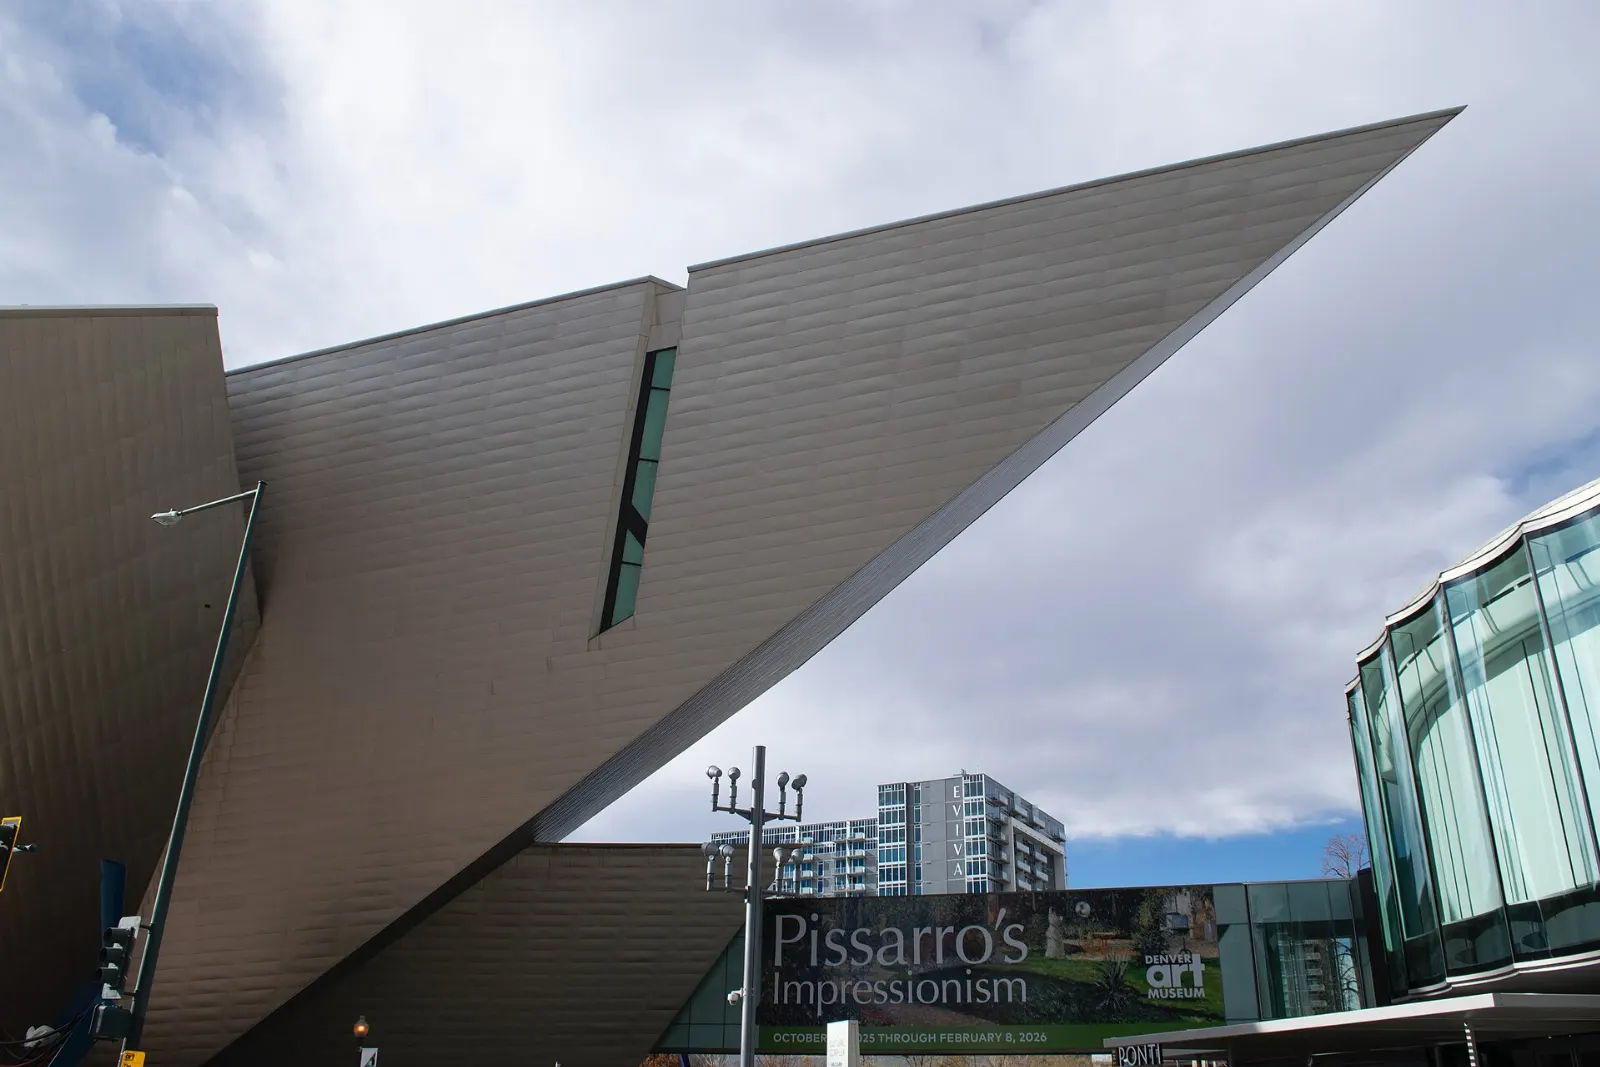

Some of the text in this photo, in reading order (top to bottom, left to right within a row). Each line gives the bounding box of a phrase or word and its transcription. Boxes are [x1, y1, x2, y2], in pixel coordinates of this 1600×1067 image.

[952, 785, 963, 876] EVIVA
[775, 908, 1029, 967] Pissarro's
[1145, 954, 1192, 965] DENVER
[1146, 953, 1205, 988] art
[773, 969, 1027, 1016] Impressionism
[1148, 988, 1206, 999] MUSEUM
[773, 1033, 828, 1044] OCTOBER
[879, 1033, 937, 1044] THROUGH
[940, 1033, 1002, 1043] FEBRUARY
[1005, 1033, 1016, 1044] 8,
[1019, 1032, 1047, 1043] 2026
[1118, 1043, 1161, 1067] PONTI
